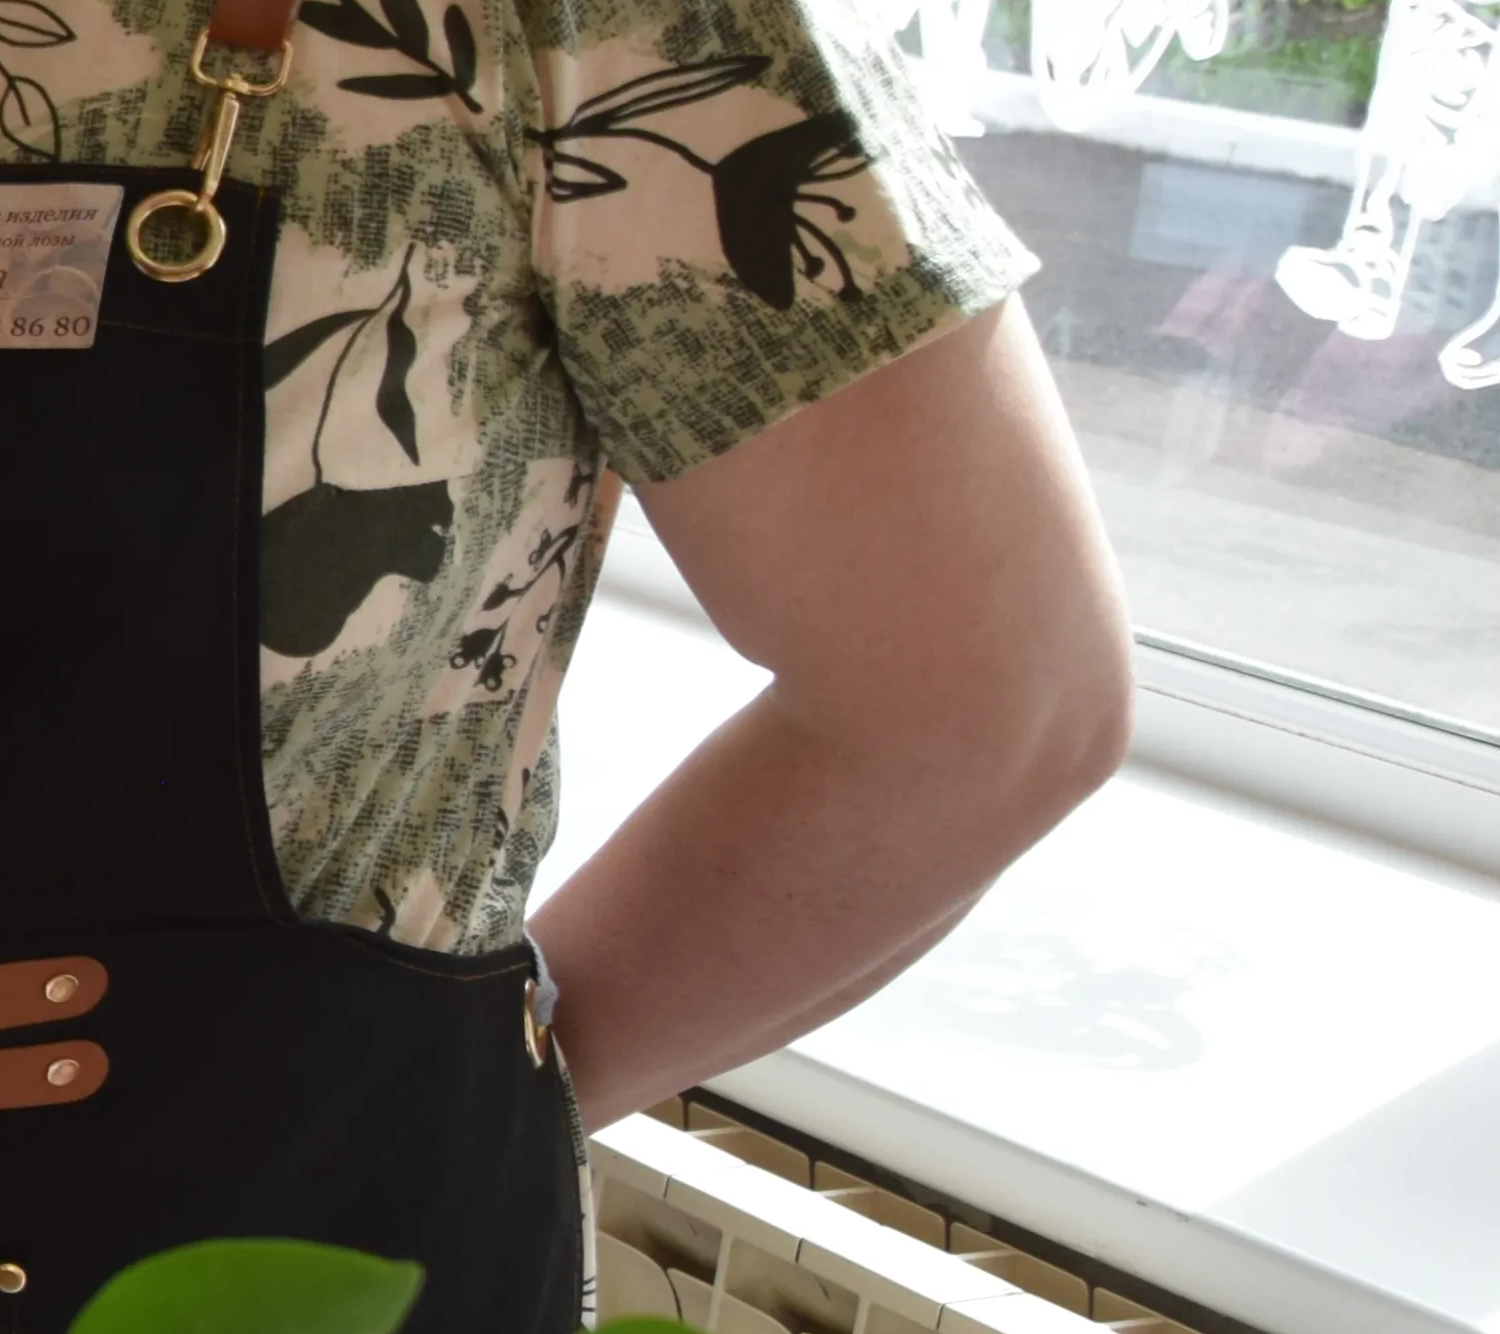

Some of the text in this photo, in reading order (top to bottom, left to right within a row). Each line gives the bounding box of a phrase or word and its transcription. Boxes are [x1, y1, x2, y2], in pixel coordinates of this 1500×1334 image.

[5, 208, 98, 224] изделия
[28, 234, 76, 247] лозы
[10, 317, 44, 336] 86
[53, 316, 91, 336] 80
